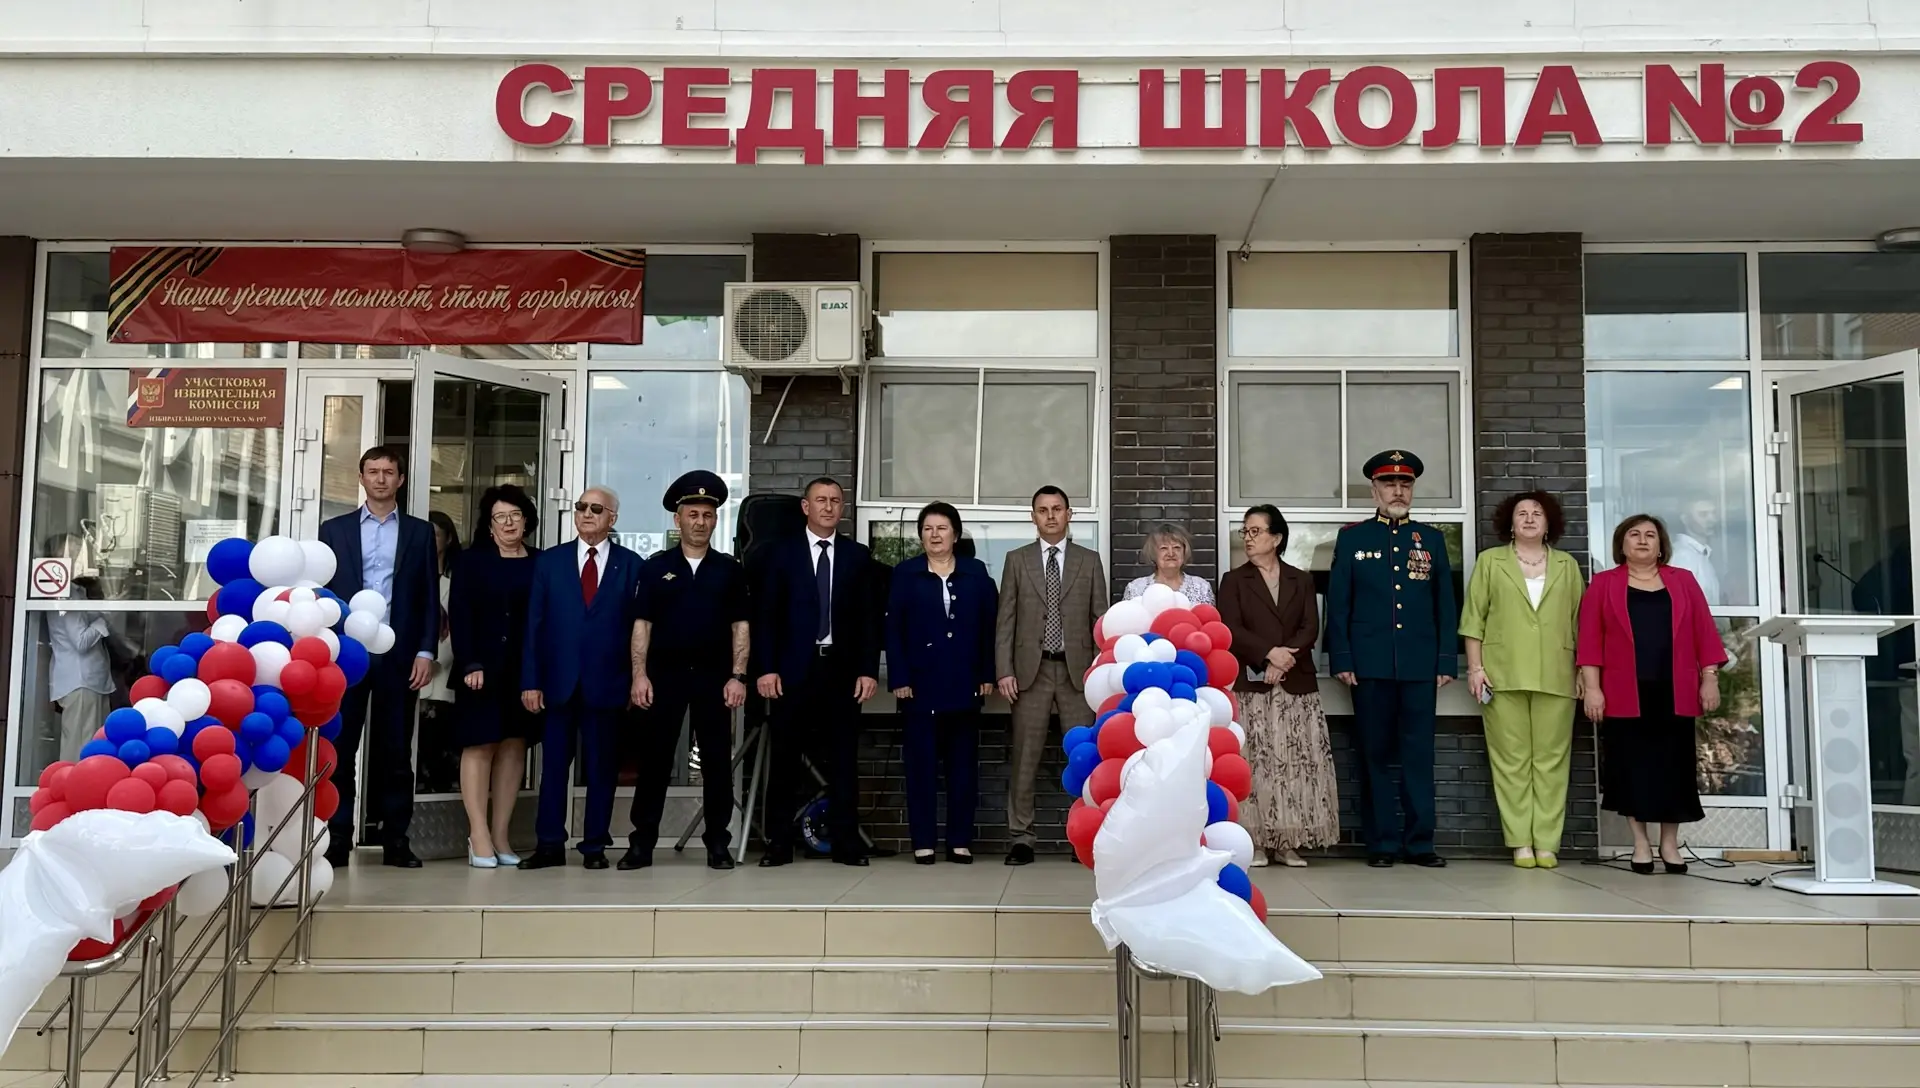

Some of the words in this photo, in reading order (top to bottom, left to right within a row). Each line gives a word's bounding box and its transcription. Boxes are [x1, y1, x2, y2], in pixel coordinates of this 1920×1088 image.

[495, 63, 1079, 166] СРЕДНЯЯ
[1138, 64, 1604, 150] ШКОЛА
[160, 277, 231, 312] Наши
[225, 283, 328, 316] ученики
[330, 283, 434, 312] помнят,
[439, 283, 512, 313] чтят,
[517, 277, 643, 319] гордятся!
[184, 377, 267, 388] УЧАСТКОВАЯ
[174, 388, 277, 399] ИЗБИРАТЕЛЬНАЯ
[188, 399, 261, 410] КОМИССИЯ
[149, 415, 212, 423] ИЗБИРАТЕЛЬНОГО
[213, 415, 246, 423] УЧАСТКА
